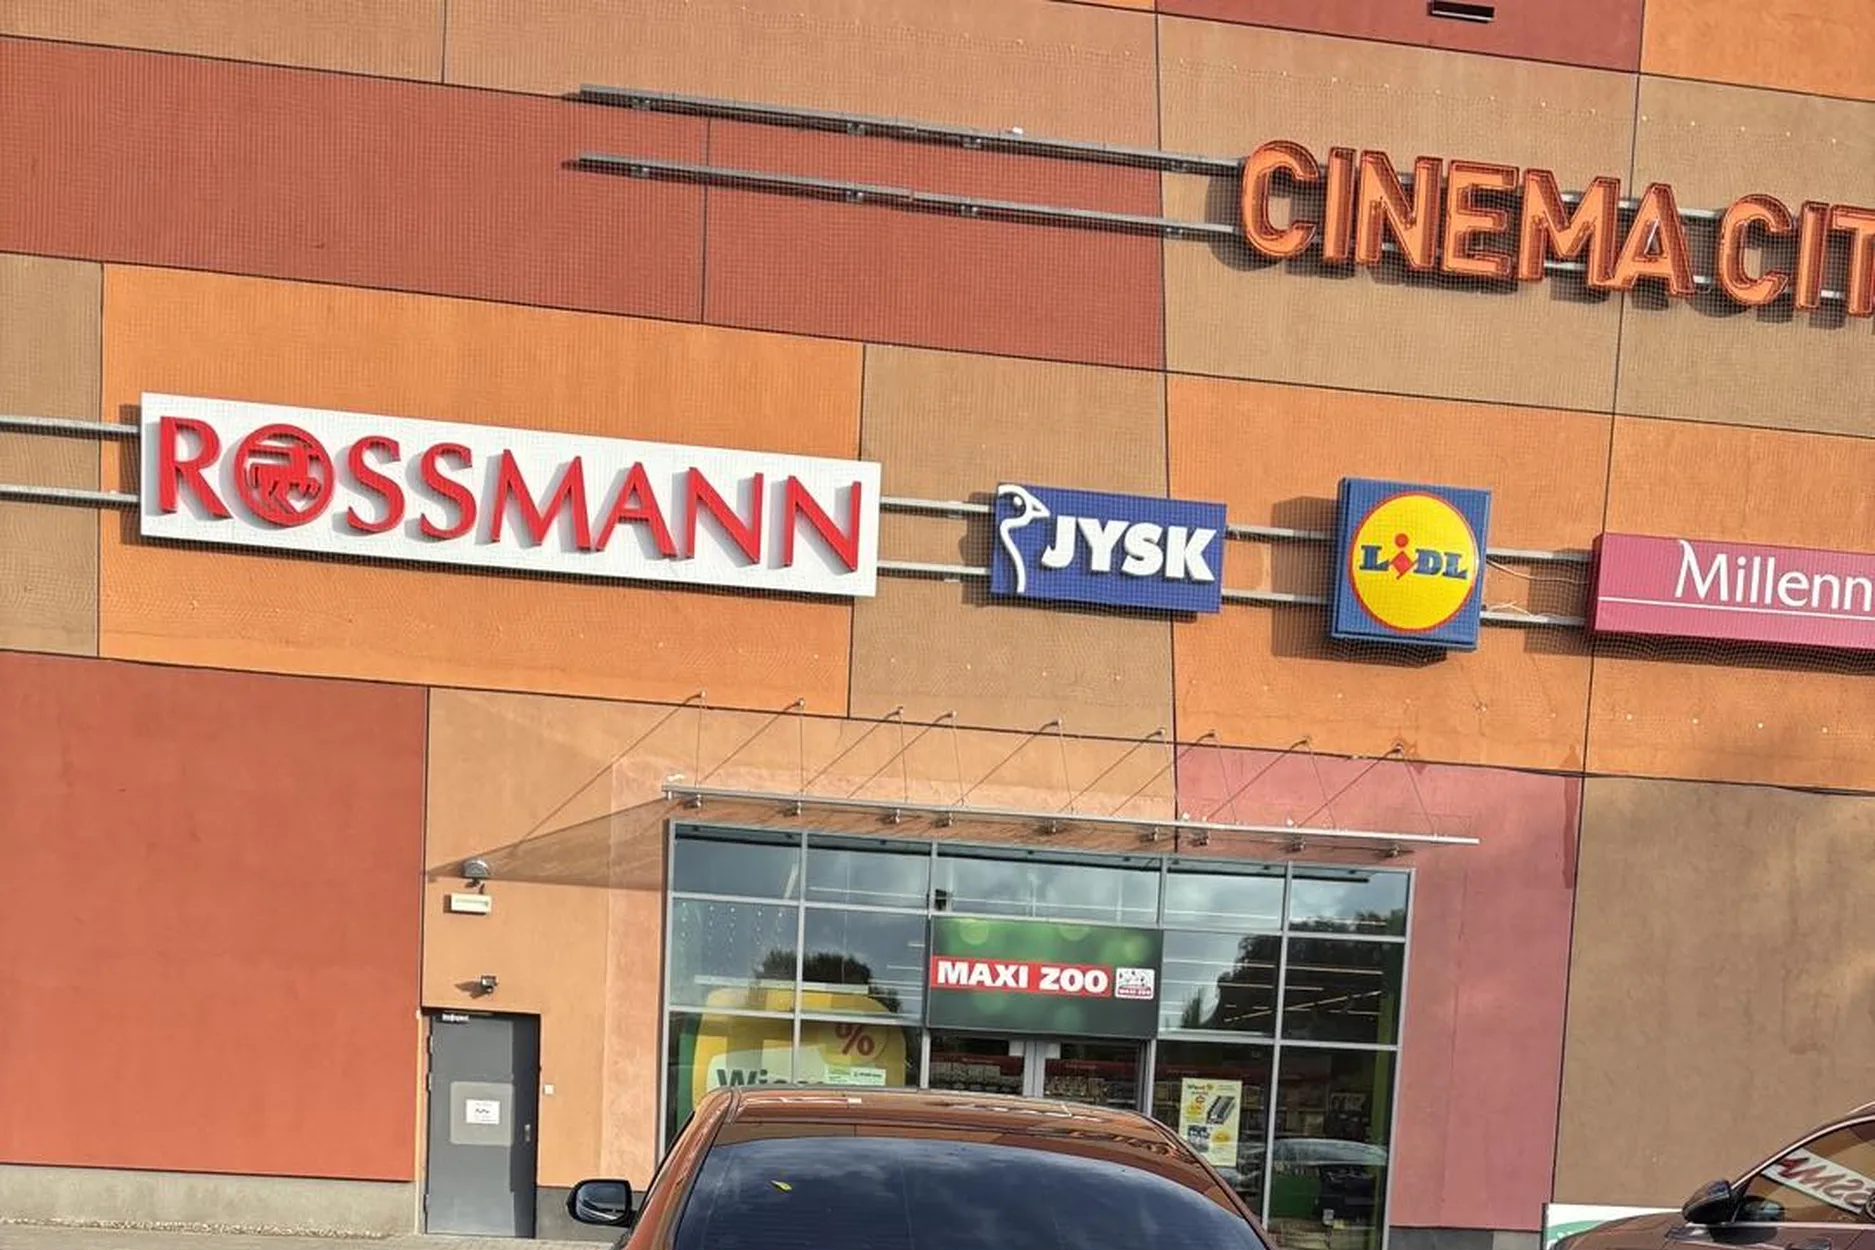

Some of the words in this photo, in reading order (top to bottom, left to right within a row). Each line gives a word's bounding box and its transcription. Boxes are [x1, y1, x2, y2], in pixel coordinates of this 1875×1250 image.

[1242, 139, 1696, 296] CINEMA
[157, 415, 863, 573] ROSSMANN
[1041, 515, 1217, 582] JYSK
[1675, 539, 1873, 613] Millenn
[937, 960, 1029, 988] MAXI
[1039, 967, 1109, 993] ZOO
